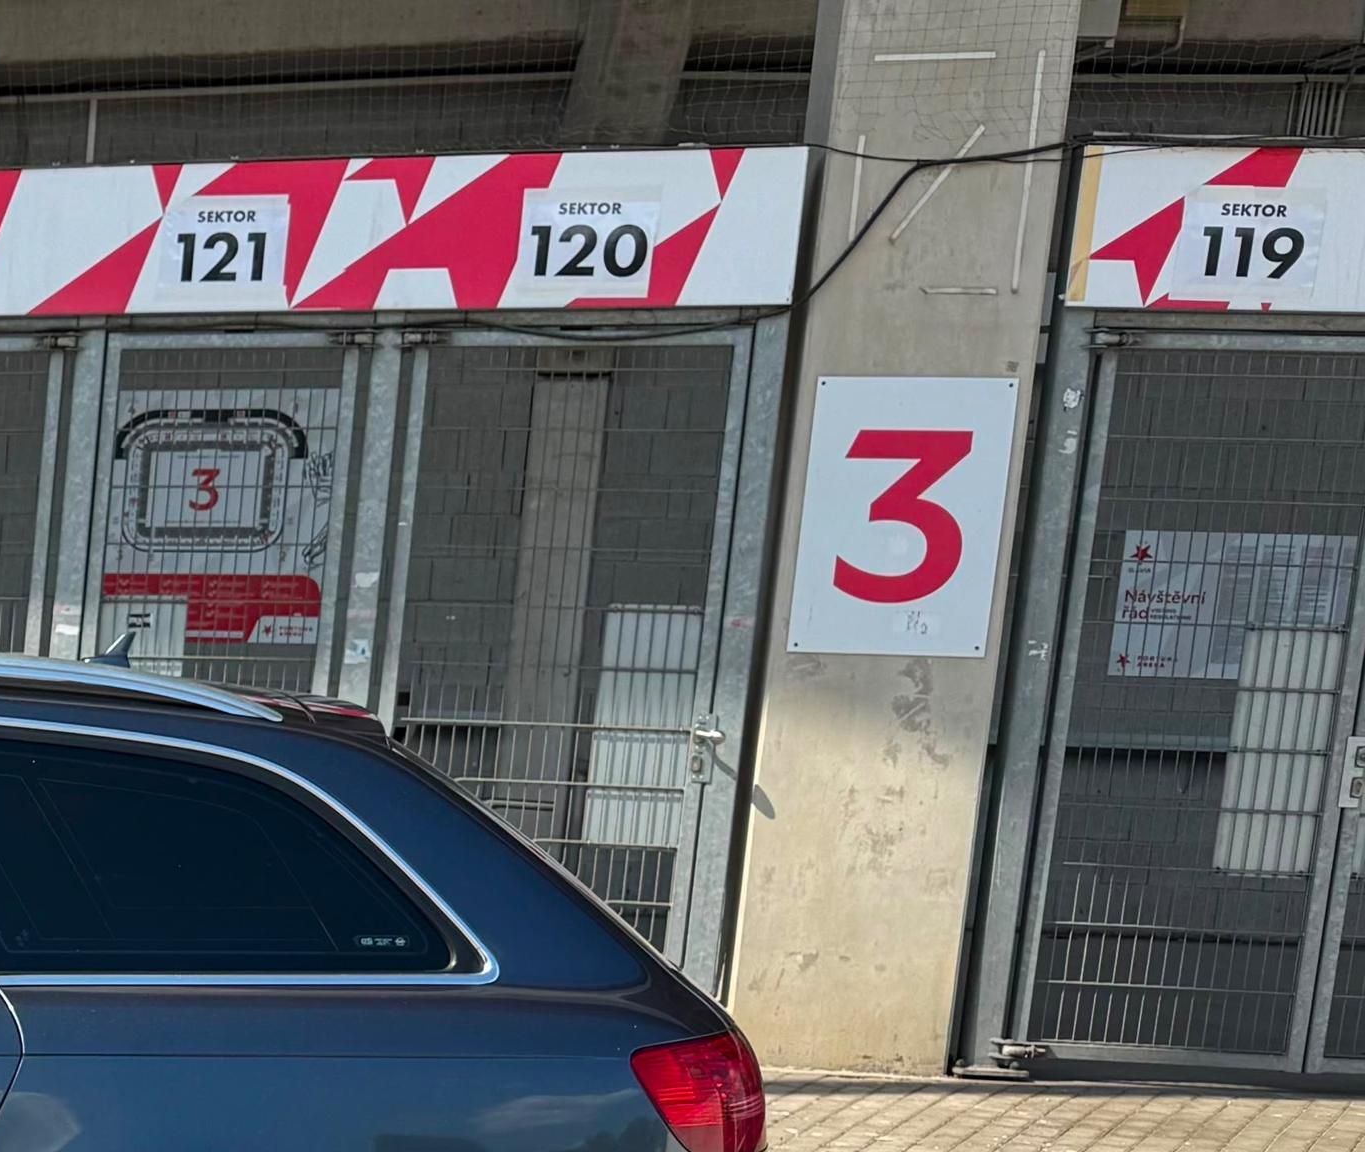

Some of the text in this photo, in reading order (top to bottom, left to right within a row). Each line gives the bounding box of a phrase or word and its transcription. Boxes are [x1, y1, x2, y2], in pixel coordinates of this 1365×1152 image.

[197, 209, 256, 223] SEKTOR
[558, 201, 622, 215] SEKTOR
[1220, 202, 1288, 217] SEKTOR
[177, 231, 268, 282] 121
[530, 223, 648, 278] 120
[1202, 225, 1305, 279] 119
[188, 468, 221, 511] 3
[832, 429, 975, 604] 3
